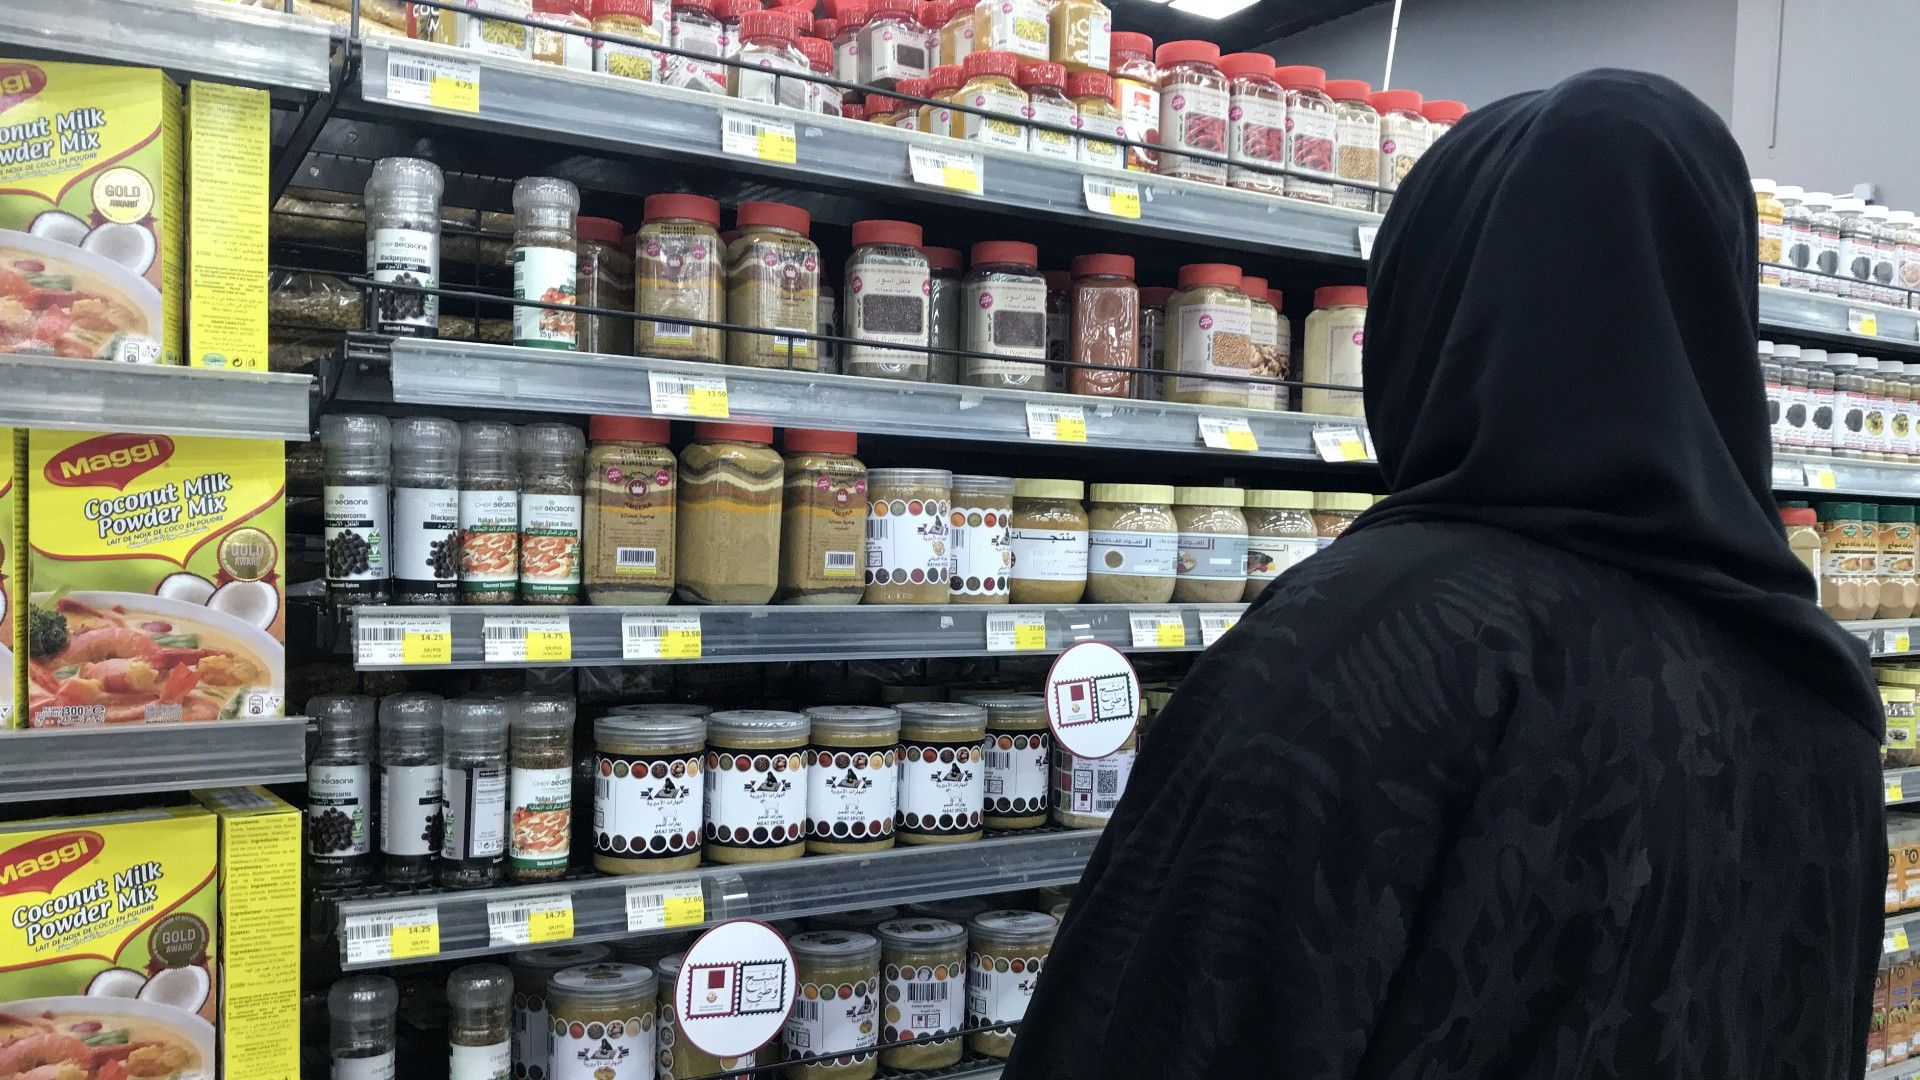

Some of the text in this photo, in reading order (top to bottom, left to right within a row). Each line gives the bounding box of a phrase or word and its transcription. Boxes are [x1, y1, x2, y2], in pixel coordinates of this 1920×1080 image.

[56, 107, 107, 133] Milk
[59, 130, 101, 155] Mix
[36, 160, 56, 169] COCO
[70, 153, 97, 163] POUDRE
[105, 184, 141, 199] GOLD
[707, 390, 727, 398] 13.50
[60, 439, 160, 479] Maggi
[84, 473, 232, 520] Coconut Milk
[544, 505, 575, 513] seasons
[98, 503, 181, 539] Powder
[188, 495, 227, 518] Mix
[545, 520, 560, 528] Spice
[106, 537, 122, 546] LAIT
[122, 535, 132, 543] DE
[133, 531, 152, 541] NOIX
[153, 529, 162, 537] DE
[164, 526, 184, 535] COCO
[196, 515, 224, 526] POUDRE
[230, 545, 264, 557] GOLD
[234, 556, 260, 566] AWARD
[421, 633, 444, 641] 14.25
[681, 630, 701, 638] 13.50
[12, 861, 164, 929] Coconut Milk
[26, 901, 113, 946] Powder
[117, 884, 158, 912] Mix
[545, 910, 566, 919] 14.75
[35, 943, 50, 953] LAIT
[52, 939, 61, 948] DE
[63, 933, 81, 944] NOIX
[83, 929, 92, 938] DE
[93, 921, 114, 934] COCO
[116, 916, 125, 925] EN
[126, 904, 155, 919] POUDRE
[162, 928, 196, 944] GOLD
[408, 925, 431, 934] 14.25
[165, 943, 193, 953] AWARD
